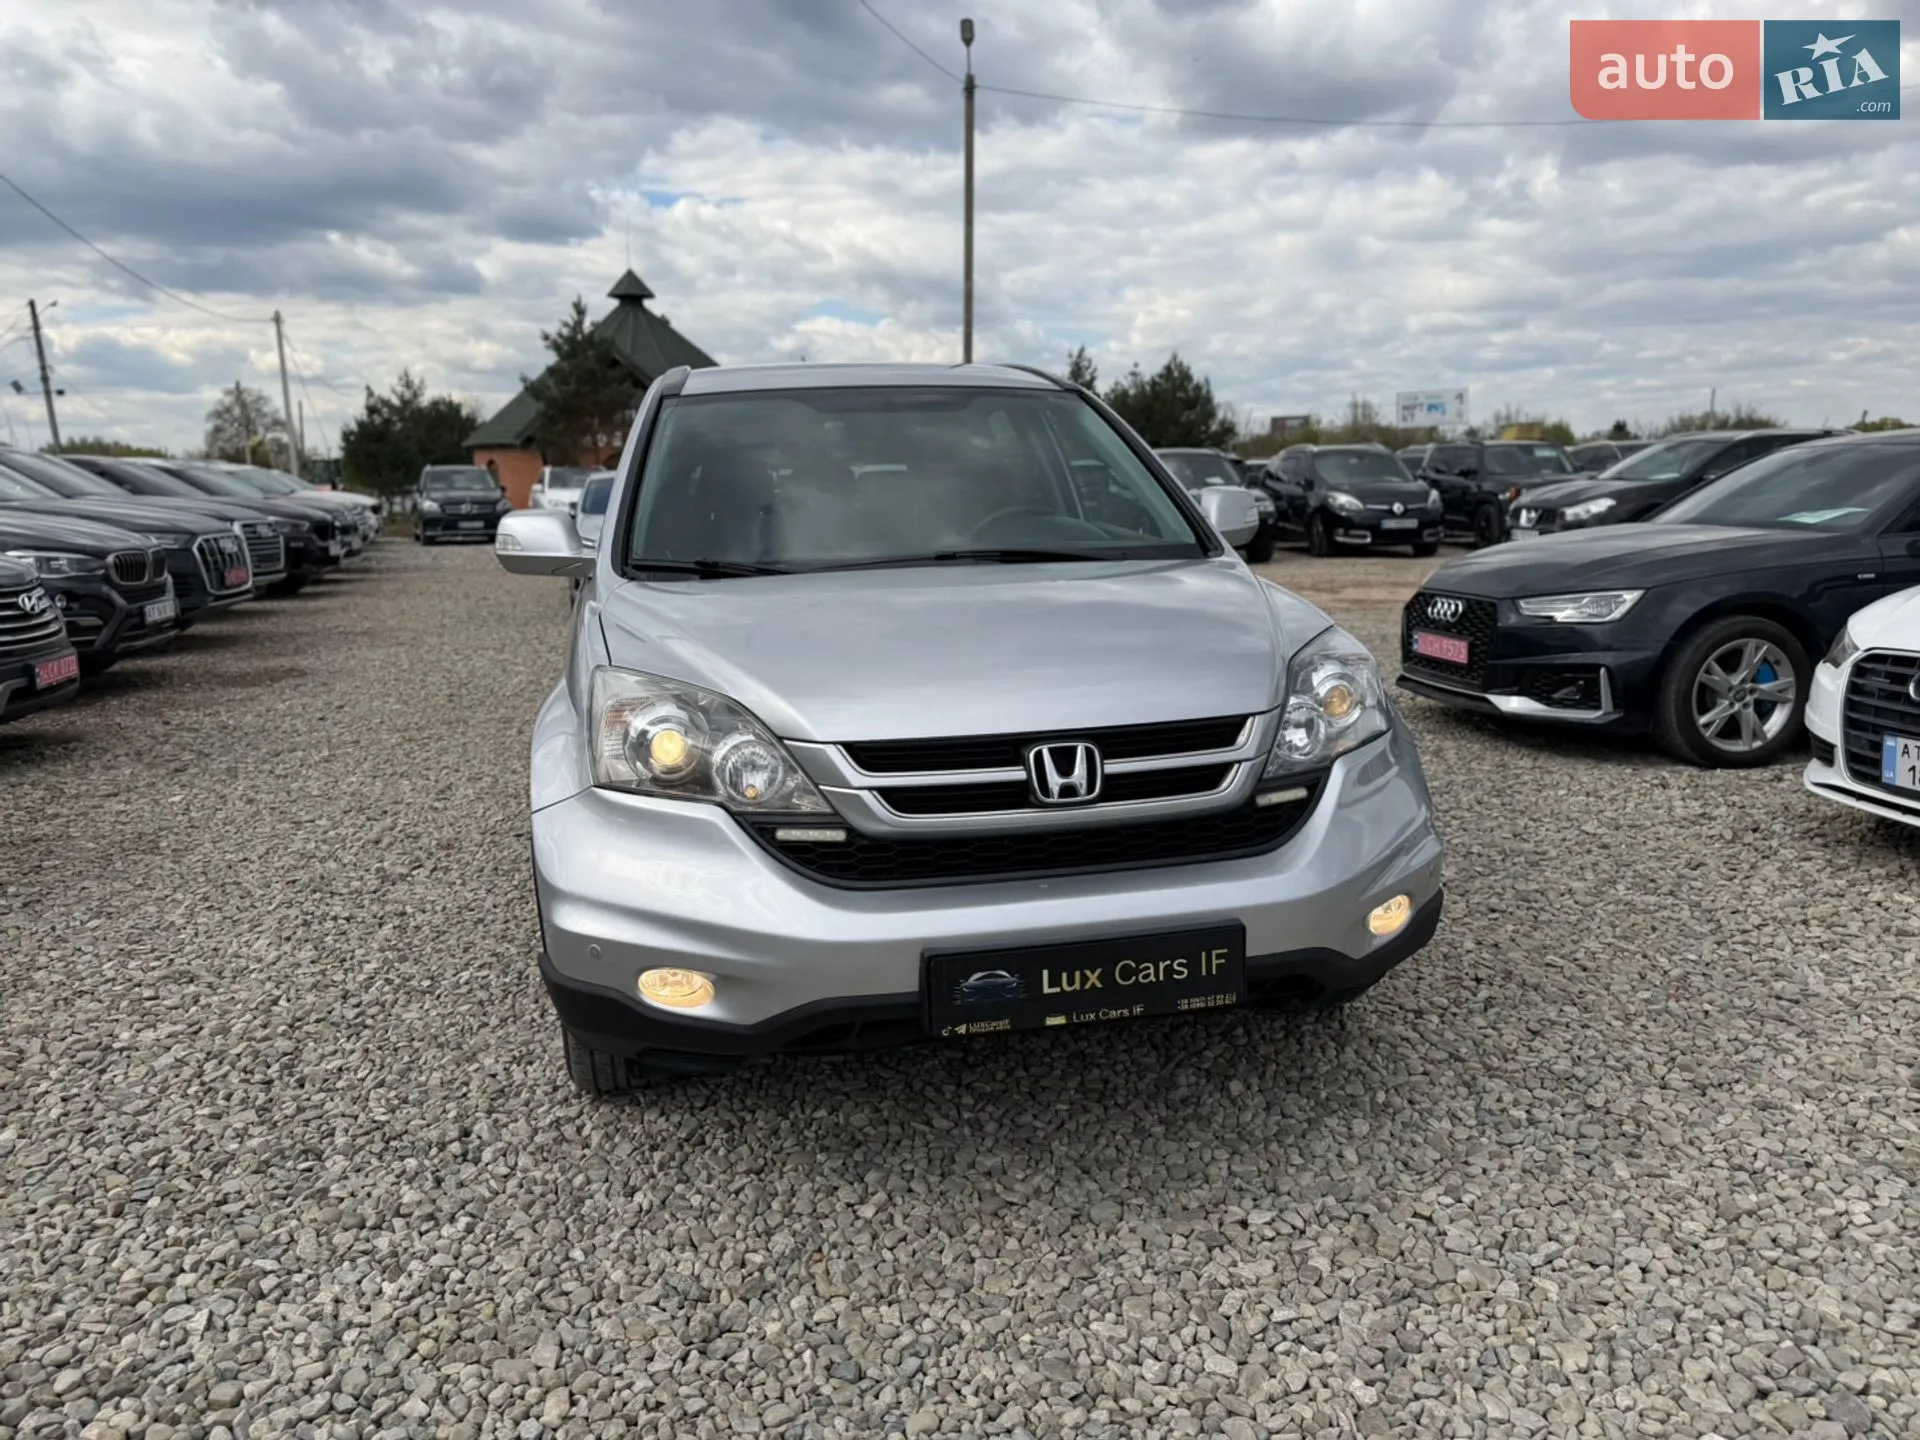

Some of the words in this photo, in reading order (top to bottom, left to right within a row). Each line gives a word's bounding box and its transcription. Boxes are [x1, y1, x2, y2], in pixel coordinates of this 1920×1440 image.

[1042, 967, 1103, 995] Lux
[1114, 958, 1188, 986] Cars
[1201, 948, 1229, 976] IF
[1072, 1010, 1096, 1022] Lux
[1099, 1006, 1130, 1020] Cars
[1132, 1003, 1145, 1016] IF
